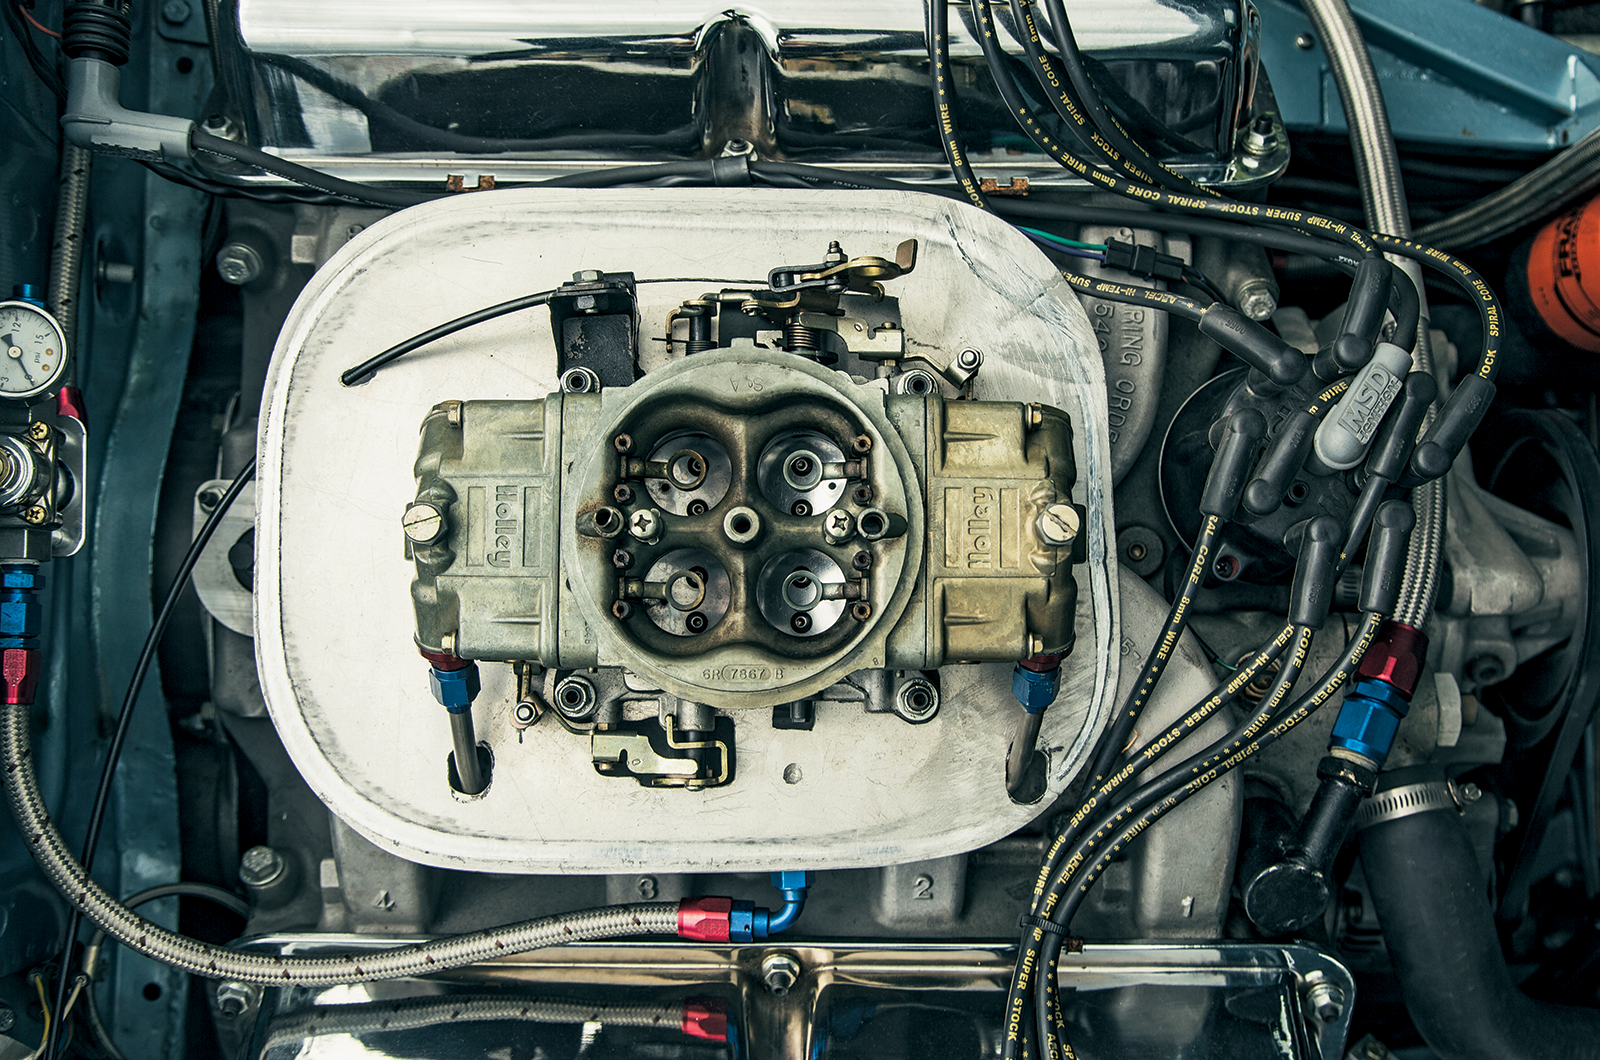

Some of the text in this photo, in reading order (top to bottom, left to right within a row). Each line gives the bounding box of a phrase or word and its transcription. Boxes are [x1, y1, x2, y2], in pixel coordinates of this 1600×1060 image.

[1025, 14, 1039, 43] 8mm
[1038, 54, 1060, 88] CORE
[1059, 91, 1086, 126] SPIRAL
[939, 103, 984, 208] CORE 8mm WIRE
[1090, 131, 1121, 161] STOCK
[1060, 151, 1087, 174] WIRE
[1092, 165, 1117, 188] 8mm
[1125, 184, 1161, 201] CORE
[1167, 194, 1207, 209] SPIRAL
[1220, 203, 1260, 216] STOCK
[1265, 208, 1302, 222] SUPER
[1306, 215, 1347, 235] HI-TEMP
[1424, 247, 1451, 263] WIRE
[1452, 260, 1472, 276] 8mm
[1096, 282, 1137, 297] HI-TEMP
[1472, 279, 1493, 301] CORE
[12, 322, 21, 332] 12
[1486, 304, 1500, 337] SPIRAL
[34, 335, 44, 345] 15
[1318, 381, 1349, 402] WIRE
[1341, 367, 1391, 433] MSD
[487, 485, 518, 569] Holley
[967, 486, 999, 569] Holley
[1189, 544, 1209, 585] CORE
[1172, 595, 1191, 624] 8mm
[1156, 630, 1177, 661] WIRE
[1350, 612, 1382, 666] HI-TEMP
[1226, 651, 1270, 695] HI-TEMP
[1242, 627, 1312, 739] CORE 8mm WIRE
[1310, 670, 1347, 707] SUPER
[1183, 695, 1222, 728] SUPER
[1269, 707, 1308, 738] STOCK
[1143, 727, 1181, 760] STOCK
[1221, 741, 1260, 770] SPIRAL
[1099, 763, 1135, 796] SPIRAL
[1069, 797, 1097, 829] CORE
[1122, 818, 1150, 843] WIRE
[1047, 834, 1067, 860] 8mm
[637, 874, 659, 900] 3
[912, 872, 935, 900] 2
[1033, 865, 1051, 896] WIRE
[371, 889, 396, 912] 4
[1032, 891, 1059, 942] HI-TMP
[1016, 948, 1036, 991] SUPER
[1007, 997, 1023, 1042] STOCK
